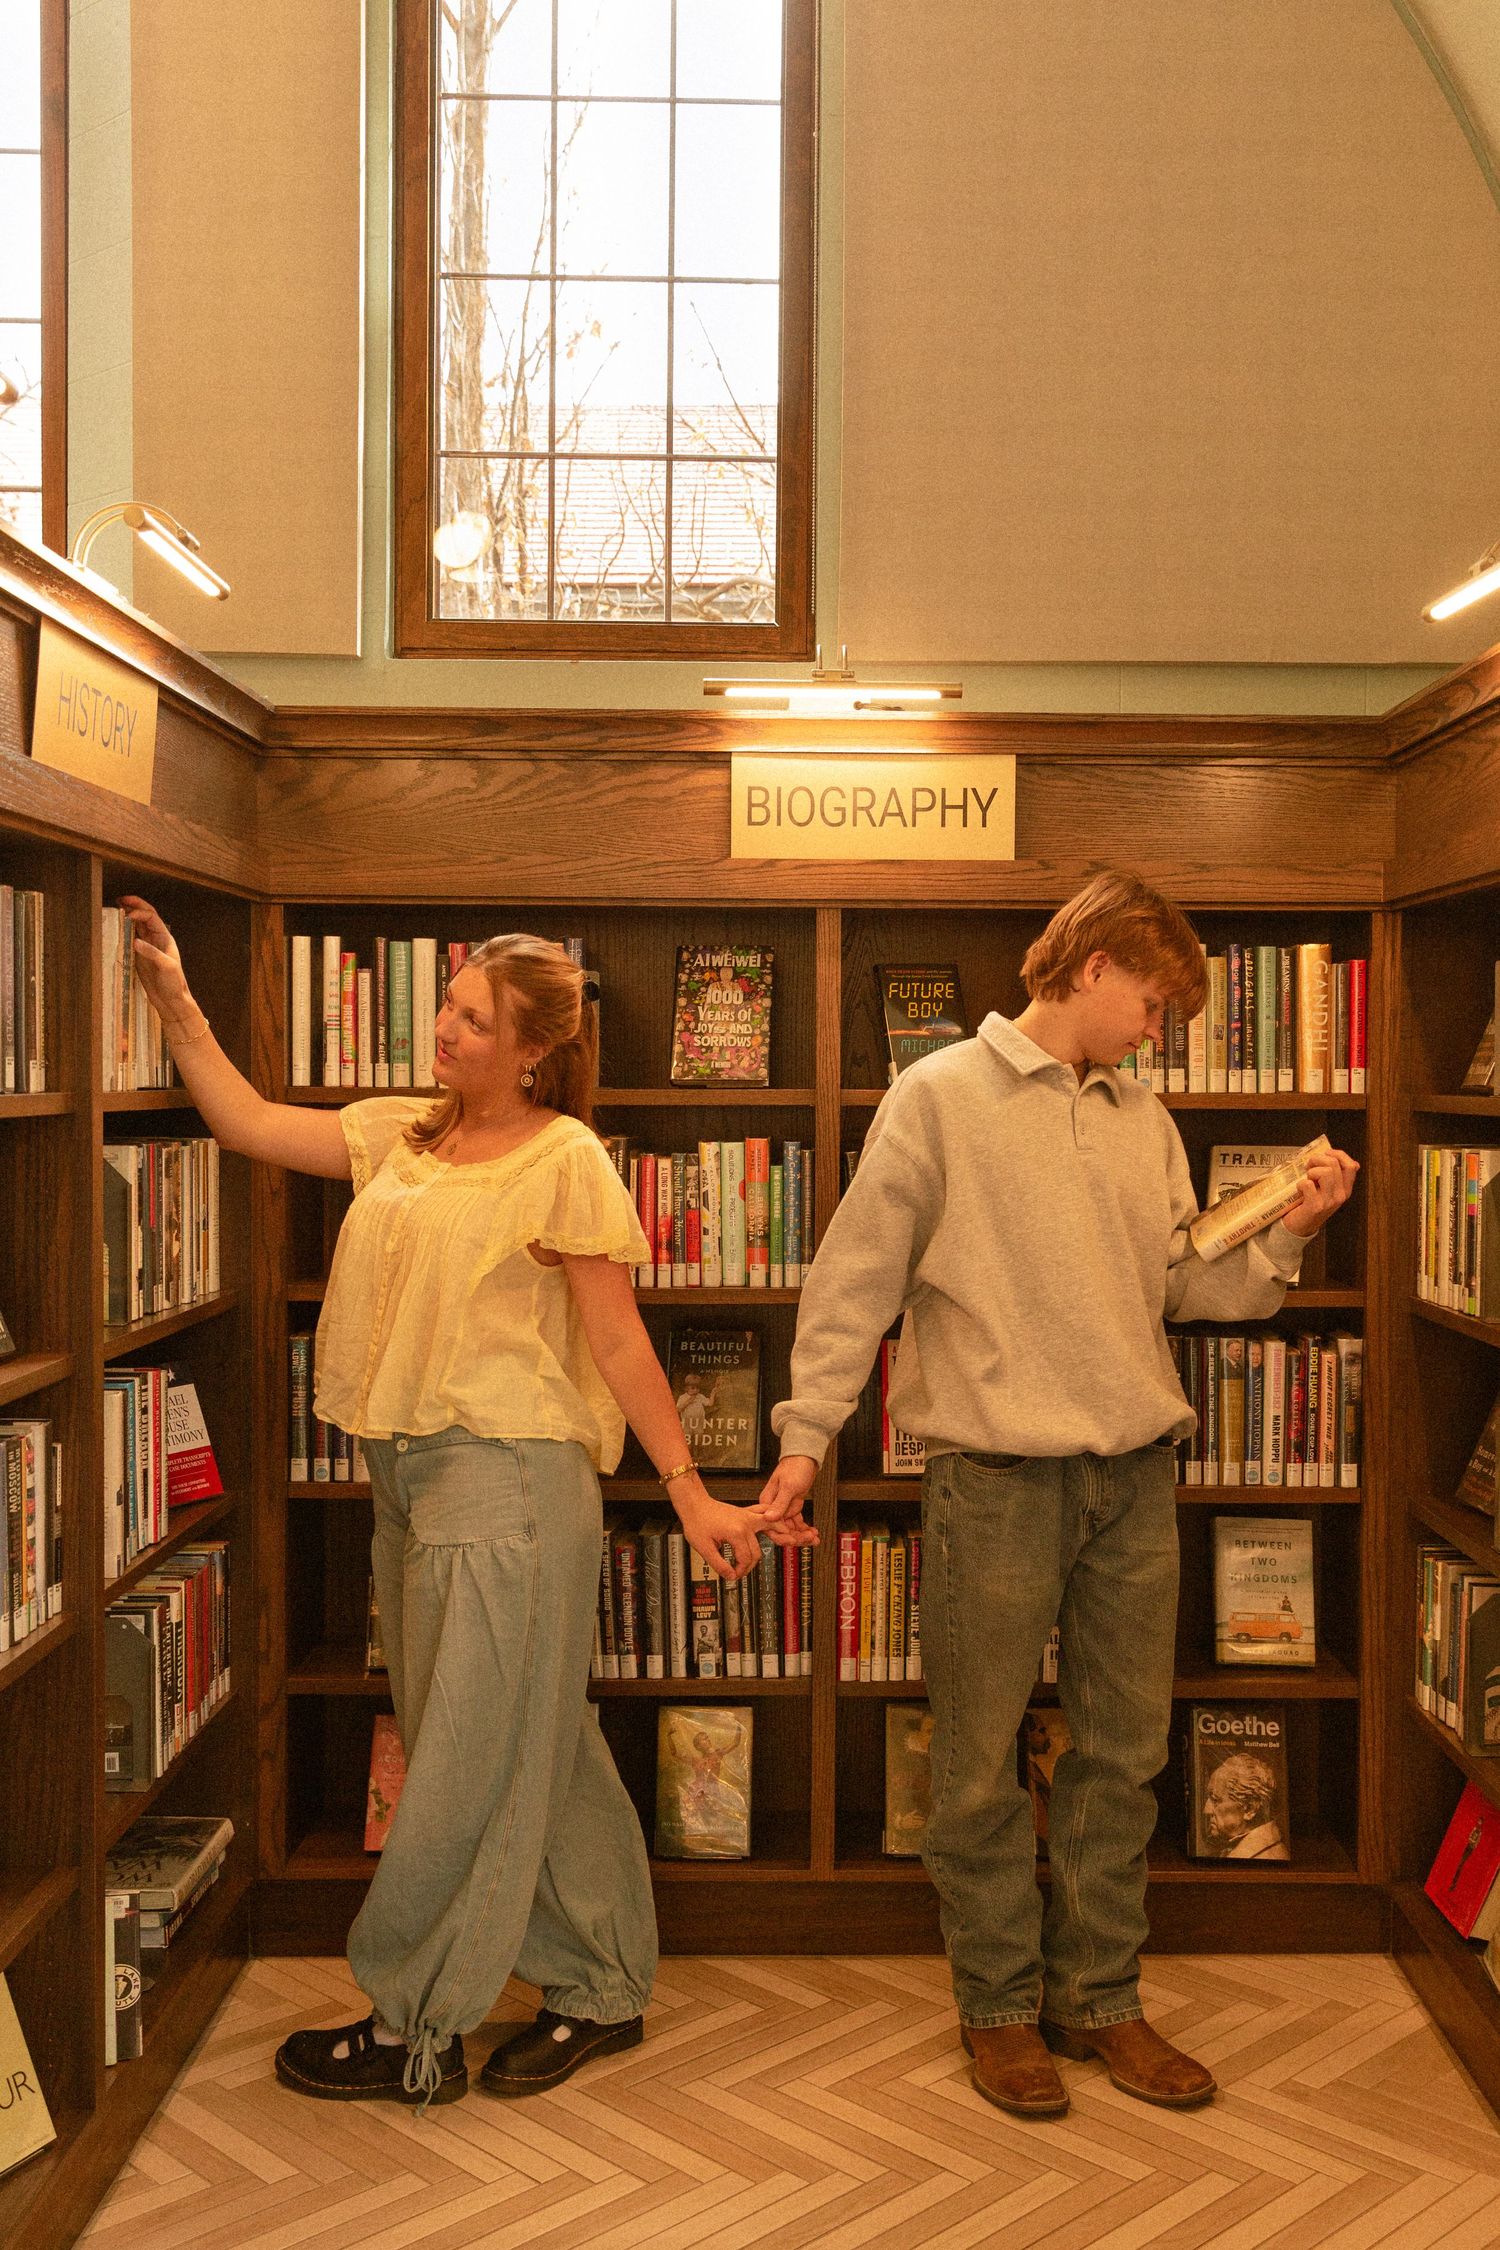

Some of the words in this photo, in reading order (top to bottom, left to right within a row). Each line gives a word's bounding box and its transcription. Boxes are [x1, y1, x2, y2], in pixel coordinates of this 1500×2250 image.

[57, 671, 138, 758] HISTORY
[746, 785, 999, 828] BIOGRAPHY
[1245, 952, 1254, 977] GOOD
[1283, 955, 1291, 992] DREAMING
[708, 989, 744, 1005] 1000
[888, 982, 955, 998] FUTURE
[1244, 980, 1254, 1010] GIRLS
[697, 1005, 735, 1022] YEARS
[907, 1001, 943, 1018] BOY
[1311, 959, 1329, 1055] GANDHI
[694, 1022, 714, 1034] JOY
[729, 1023, 753, 1034] AND
[693, 1036, 752, 1047] SORROWS
[900, 1039, 955, 1053] MICHA
[1193, 1033, 1203, 1050] HAVE
[786, 1145, 797, 1162] Easy
[1219, 1152, 1297, 1166] TRANN
[727, 1149, 735, 1182] SOLUTIONS
[787, 1162, 797, 1183] Crafts
[660, 1172, 669, 1188] LONG
[673, 1166, 684, 1193] Should
[660, 1189, 669, 1201] WAY
[773, 1182, 781, 1200] STILL
[660, 1202, 669, 1218] HOME
[673, 1195, 684, 1216] Have
[756, 1196, 764, 1236] BROWNS
[773, 1201, 781, 1218] HERE
[673, 1218, 684, 1247] Honor
[1229, 1221, 1256, 1243] TIMOTHY
[680, 1341, 753, 1352] BEAUTIFUL
[690, 1354, 740, 1364] THINGS
[1309, 1346, 1318, 1373] EDDIE
[1326, 1366, 1334, 1391] MIGHT
[1253, 1375, 1262, 1421] ANTHONY
[1309, 1375, 1318, 1409] HUANG
[167, 1406, 190, 1421] EN'S
[1326, 1393, 1334, 1420] REGRET
[1271, 1414, 1281, 1436] MARK
[167, 1429, 206, 1446] TIMONY
[685, 1434, 738, 1446] BIDEN
[895, 1441, 927, 1456] DESP
[1253, 1423, 1262, 1460] HOPKIN
[1271, 1438, 1281, 1463] HOPPU
[895, 1458, 913, 1467] JOHN
[8, 1461, 18, 1513] MOSCOW
[1234, 1539, 1293, 1551] BETWEEN
[602, 1554, 610, 1576] SPEED
[621, 1552, 633, 1587] UNTAMED
[801, 1547, 811, 1571] ORA
[892, 1552, 903, 1581] LESLIE
[1250, 1557, 1278, 1567] TWO
[12, 1572, 21, 1611] SULLIVAN
[839, 1537, 857, 1630] LEBRON
[622, 1592, 633, 1626] GLENNON
[801, 1576, 811, 1627] EPHRON
[910, 1604, 921, 1634] STEVE
[623, 1627, 634, 1651] DOYLE
[892, 1628, 903, 1658] JONES
[910, 1636, 921, 1656] JON
[1198, 1713, 1280, 1737] Goethe
[123, 1968, 140, 1990] LAKE
